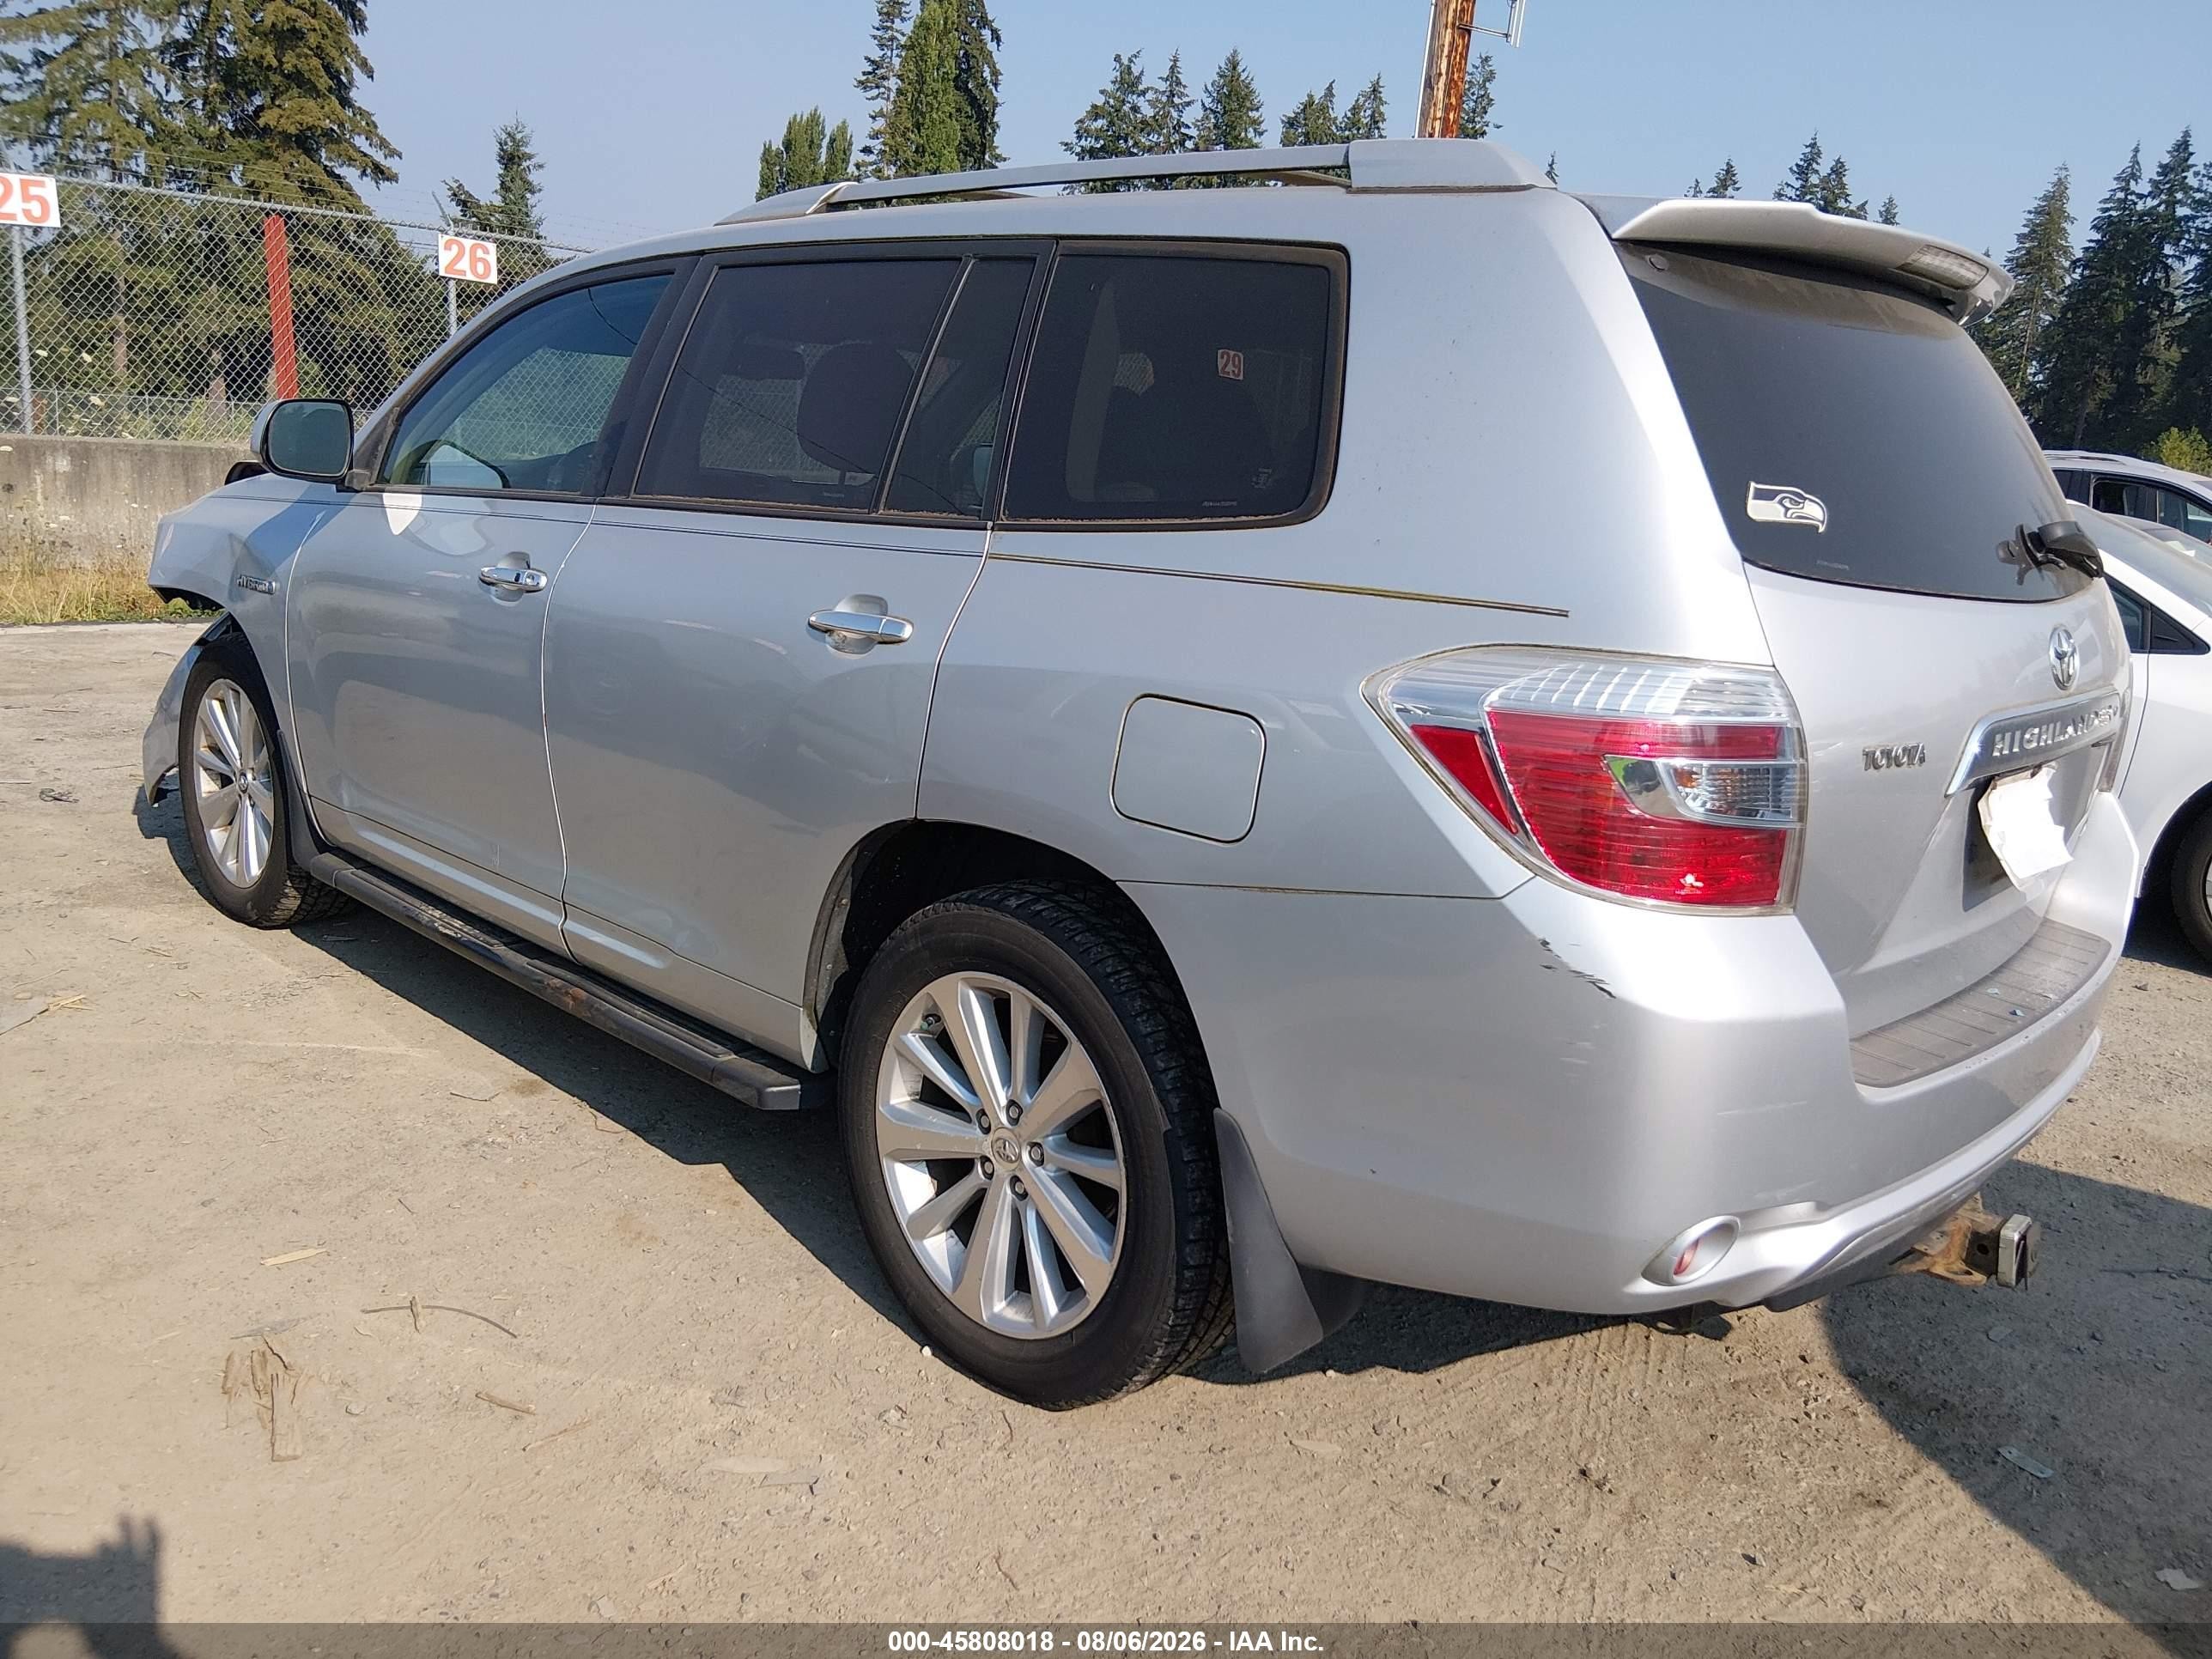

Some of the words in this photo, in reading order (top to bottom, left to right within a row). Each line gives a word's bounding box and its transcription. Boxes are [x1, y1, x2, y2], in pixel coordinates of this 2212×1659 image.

[443, 238, 492, 280] 26
[1220, 350, 1242, 378] 29
[1862, 742, 1926, 771] TOYOTA
